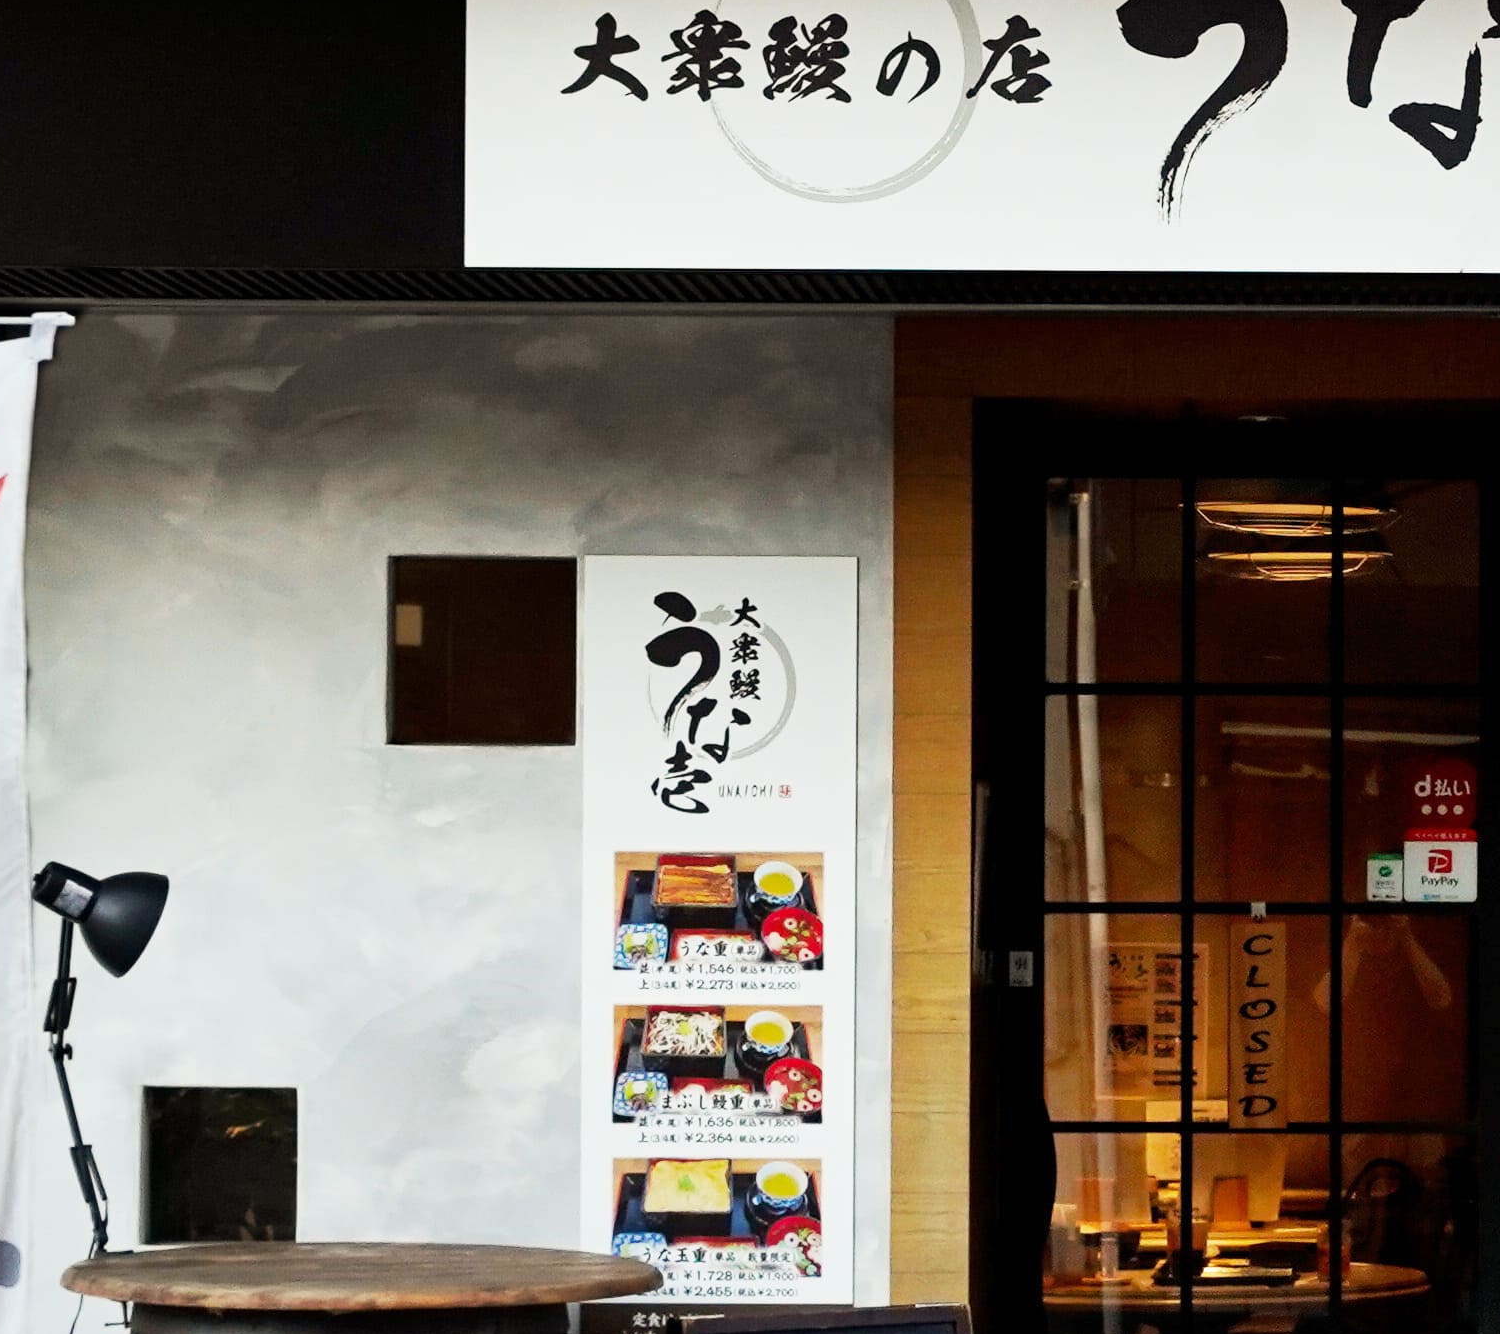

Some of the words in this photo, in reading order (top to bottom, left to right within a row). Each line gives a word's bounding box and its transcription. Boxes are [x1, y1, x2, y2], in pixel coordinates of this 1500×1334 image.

[562, 11, 1053, 105] 大衆鰻の店
[645, 591, 751, 814] うな壱
[1414, 774, 1471, 798] d払い
[1421, 875, 1459, 888] PayPay
[1238, 934, 1277, 1117] CLOSED
